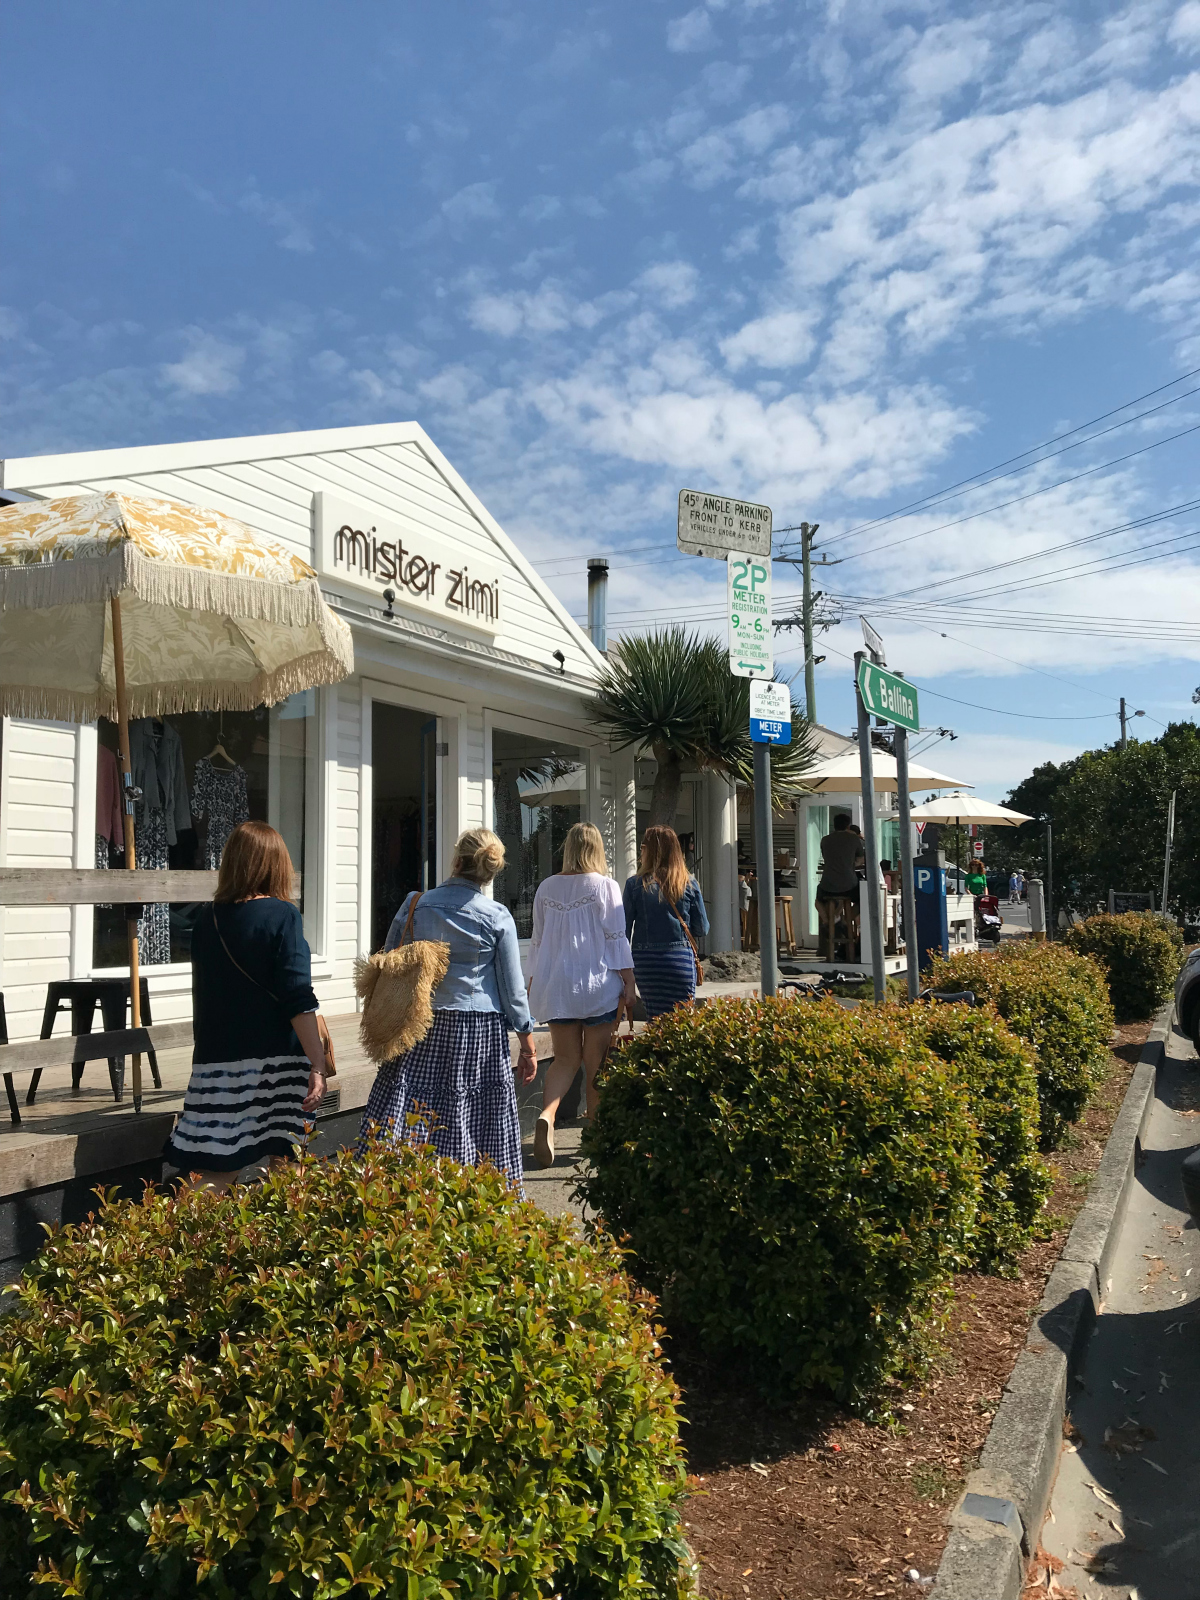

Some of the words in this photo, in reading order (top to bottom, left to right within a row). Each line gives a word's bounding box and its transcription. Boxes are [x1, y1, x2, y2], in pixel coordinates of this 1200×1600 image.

[703, 497, 730, 513] ANGLE
[735, 504, 768, 521] PARKING
[690, 510, 718, 524] FRONT
[724, 516, 733, 527] TO
[740, 520, 761, 533] KERB
[691, 523, 715, 534] VEHICLES
[339, 525, 441, 595] mister
[449, 566, 499, 620] zimi
[732, 561, 767, 592] 2P
[733, 590, 765, 605] METER
[732, 602, 768, 615] REGISTRATION
[733, 648, 748, 657] PUBLIC
[750, 650, 769, 660] HOLIDAYS
[772, 695, 785, 703] PLATE
[879, 677, 914, 721] Ballina
[759, 720, 783, 733] METER
[917, 869, 931, 889] P
